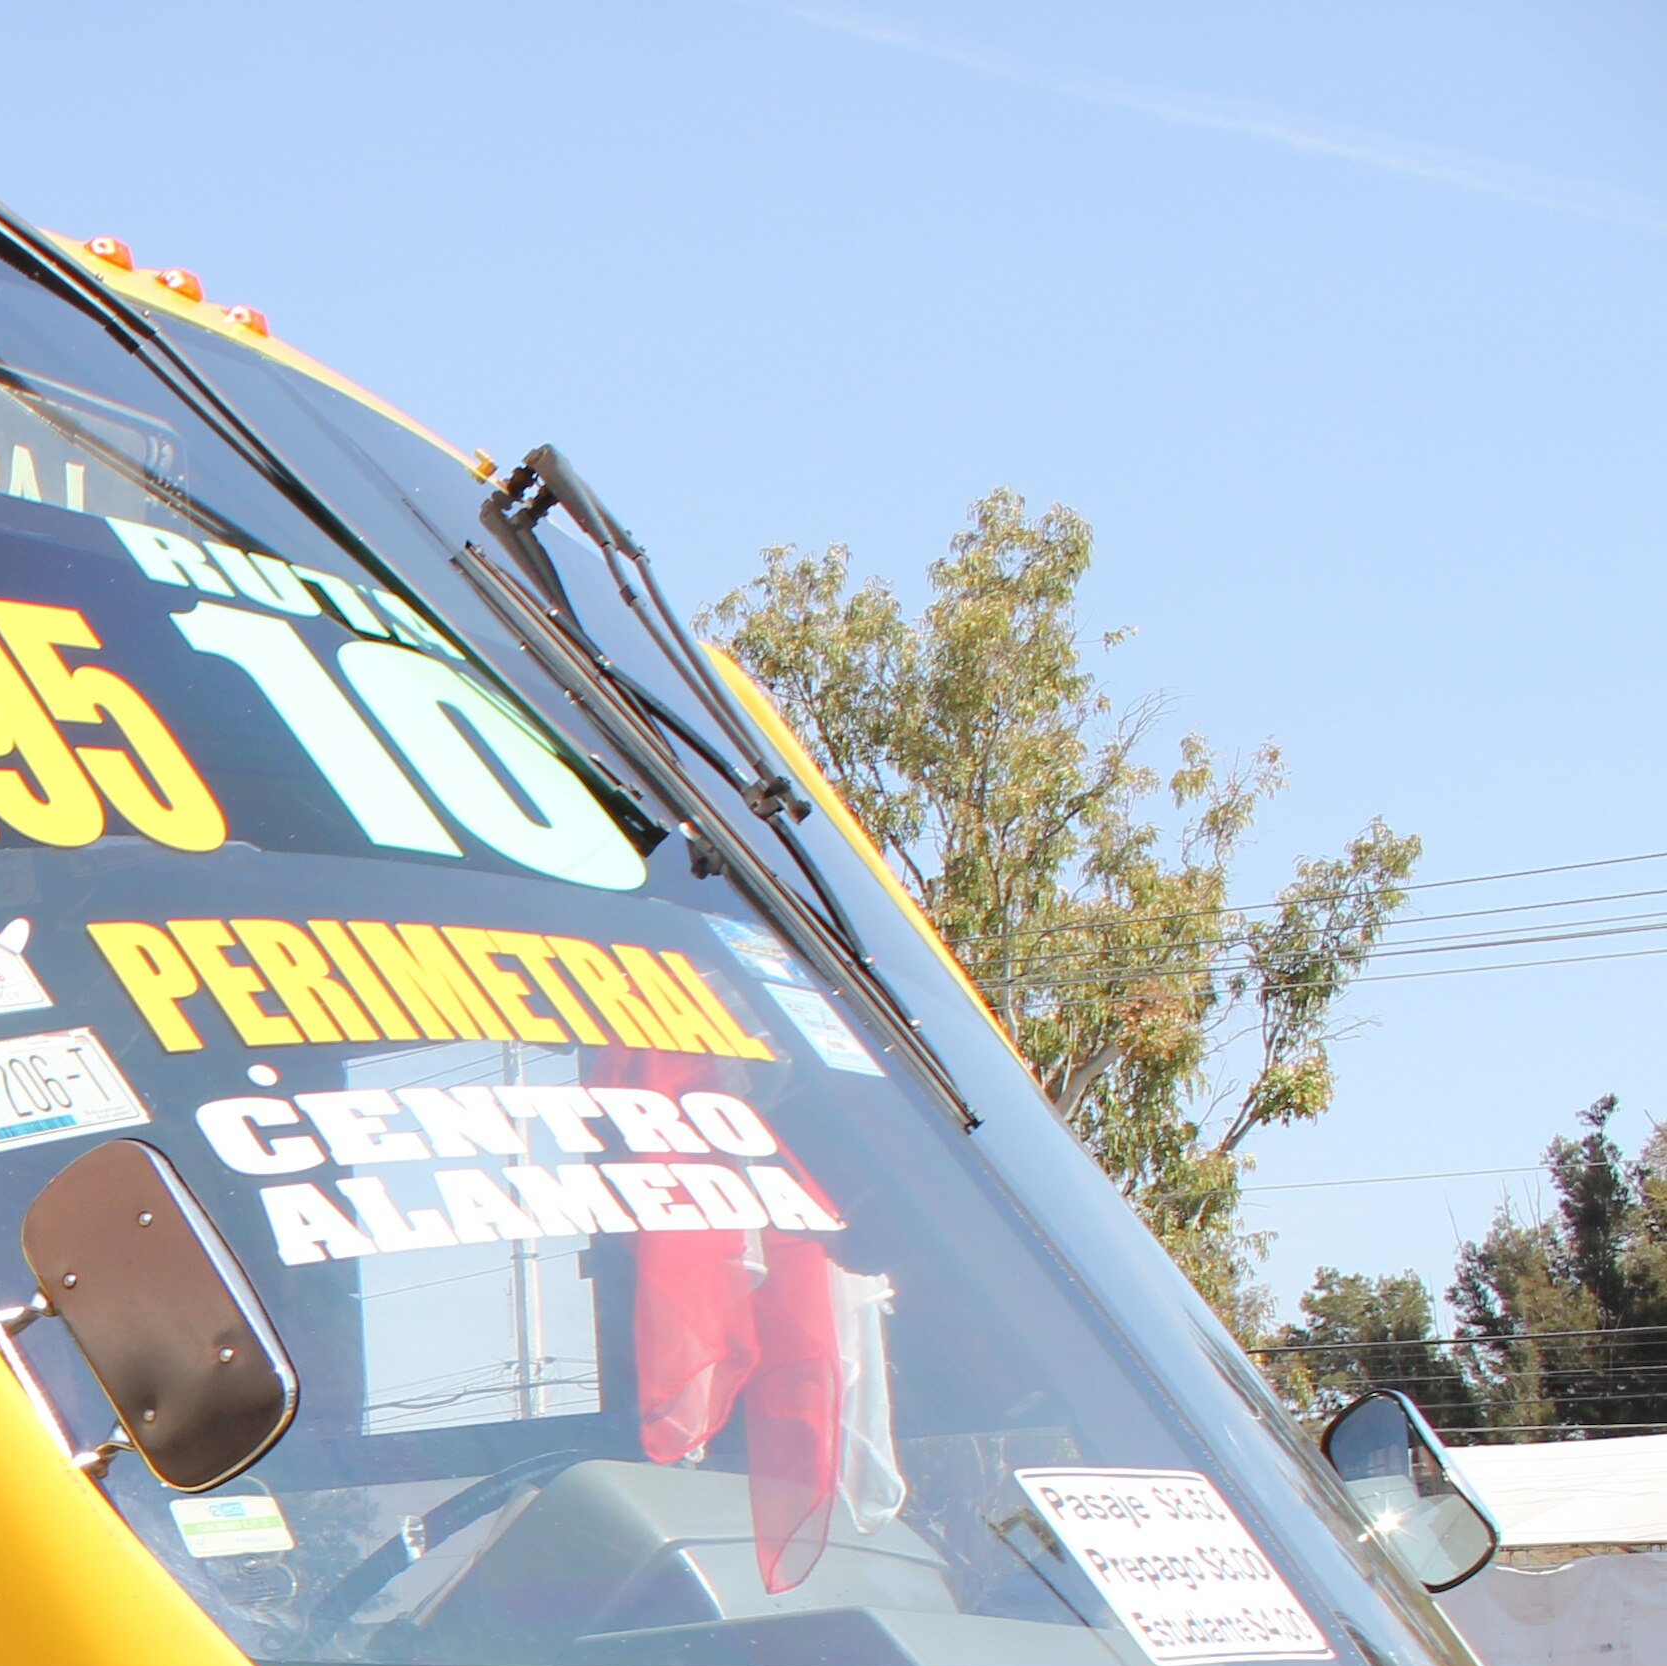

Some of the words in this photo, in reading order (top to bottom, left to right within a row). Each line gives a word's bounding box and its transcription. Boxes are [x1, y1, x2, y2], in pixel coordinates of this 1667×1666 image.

[168, 600, 647, 892] 10
[85, 919, 776, 1063] PERIMETRAL
[195, 1085, 778, 1175] CENTRO
[258, 1163, 845, 1266] ALAMEDA
[1040, 1486, 1152, 1529] Pasaje
[1084, 1548, 1206, 1590] Prepago
[1195, 1546, 1272, 1582] $8.00
[1131, 1610, 1255, 1647] Estudiante
